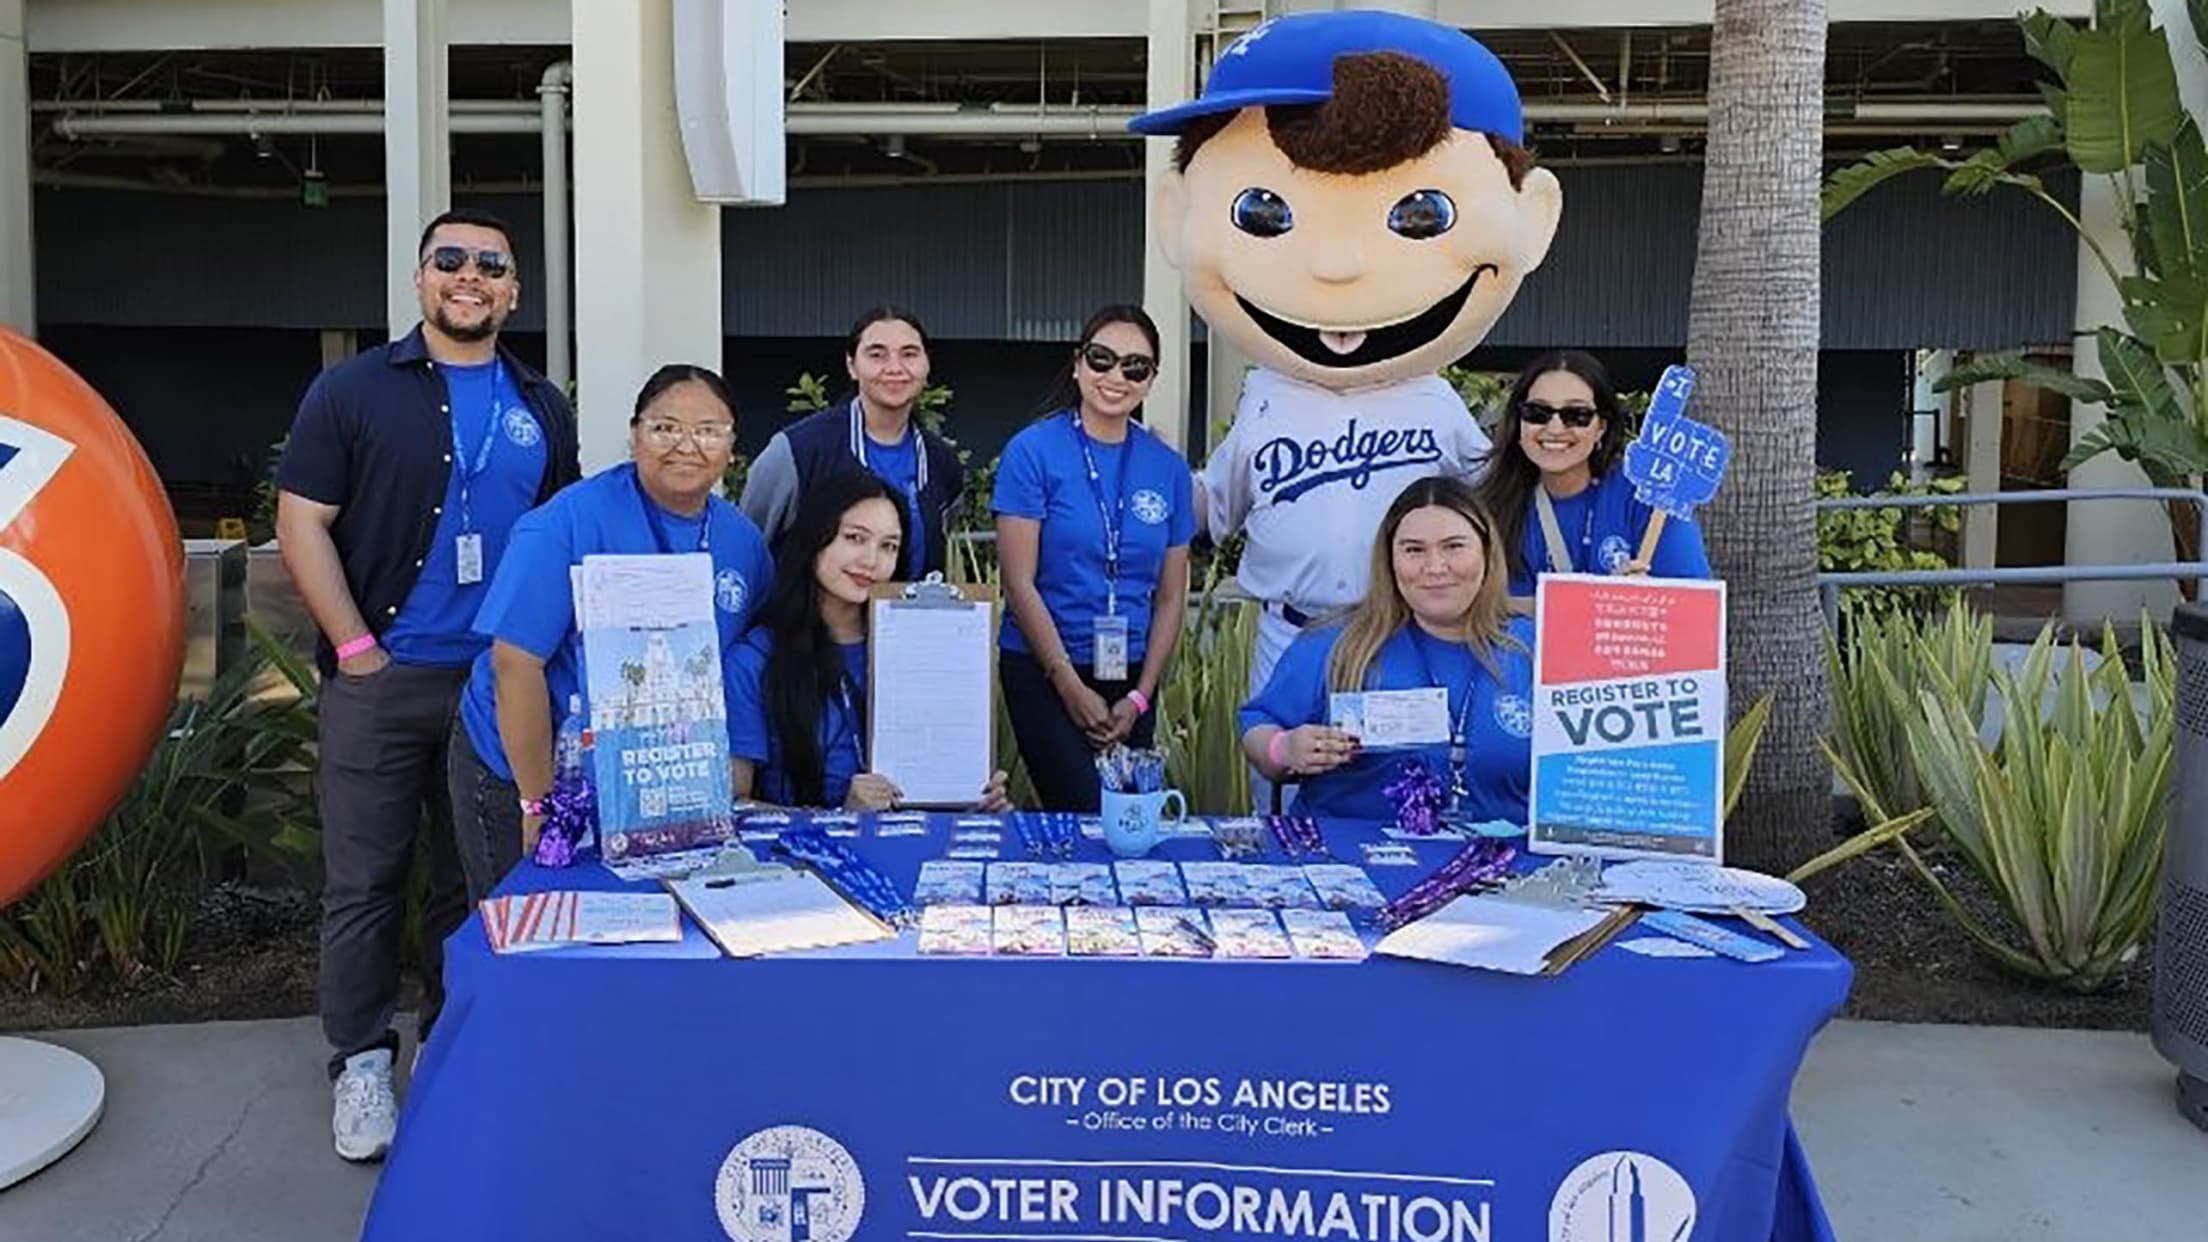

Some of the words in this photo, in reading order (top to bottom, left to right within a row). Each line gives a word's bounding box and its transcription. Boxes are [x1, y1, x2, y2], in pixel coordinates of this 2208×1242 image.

[1254, 418, 1443, 502] Dodgers
[1652, 422, 1720, 470] VOTE
[1650, 457, 1674, 482] LA
[1551, 682, 1660, 706] REGISTER
[1667, 678, 1698, 697] TO
[1555, 697, 1703, 746] VOTE
[623, 768, 652, 784] TO
[656, 760, 710, 780] VOTE
[1009, 1075, 1087, 1105] CITY
[1098, 1077, 1147, 1106] OF
[1157, 1077, 1222, 1107] LOS
[1231, 1078, 1391, 1114] ANGELES
[1083, 1111, 1147, 1130] Office
[1152, 1111, 1174, 1130] of
[1180, 1111, 1213, 1131] the
[1217, 1113, 1259, 1137] City
[1263, 1116, 1318, 1137] Clerk
[908, 1176, 1079, 1222] VOTER
[1099, 1178, 1491, 1242] INFORMATION
